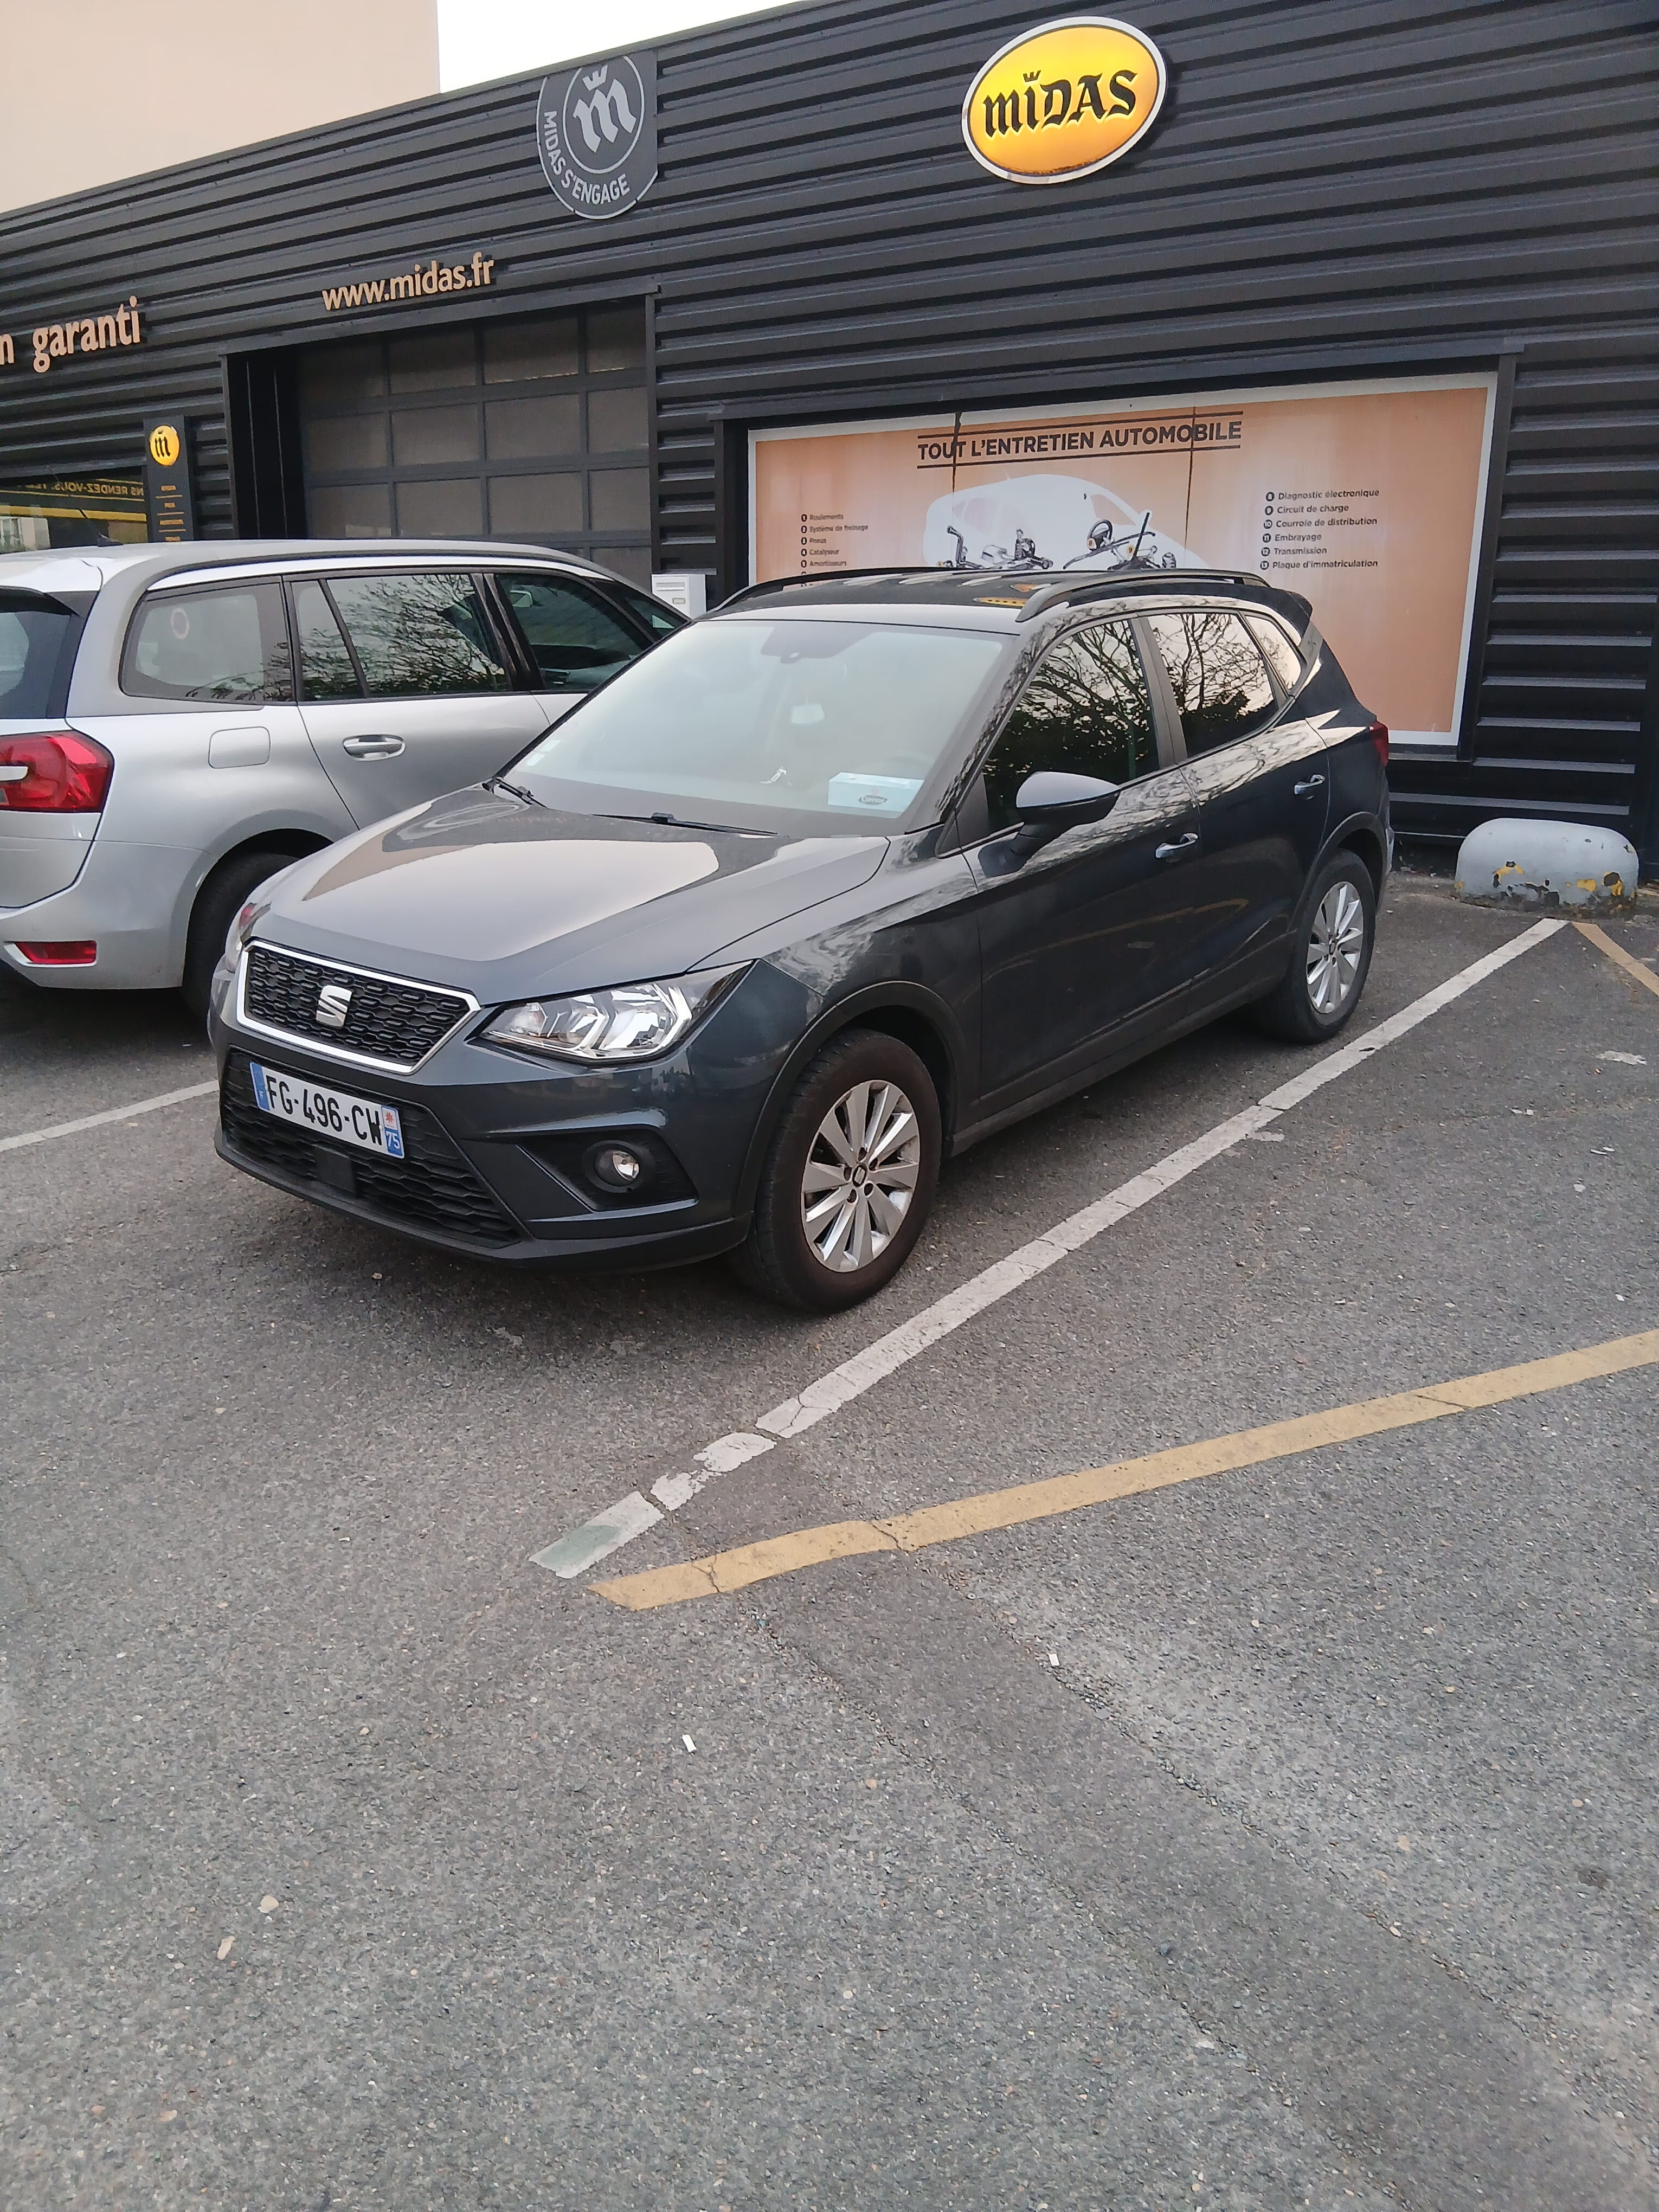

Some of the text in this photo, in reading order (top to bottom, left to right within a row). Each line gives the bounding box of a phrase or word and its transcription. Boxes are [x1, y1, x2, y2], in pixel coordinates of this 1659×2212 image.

[544, 111, 631, 204] MIDAS S'ENGAGE
[322, 252, 494, 311] www.midas.fr
[33, 295, 140, 373] garanti
[917, 421, 1242, 461] TOUT L'ENTRETIEN AUTOMOBILE
[1278, 491, 1322, 500] Diagnostic
[1325, 489, 1379, 498] électronique
[1320, 505, 1349, 513] charge
[1328, 517, 1377, 526] distribution
[1275, 533, 1322, 542] Embrayage
[1274, 546, 1327, 555] Transmission
[1272, 561, 1300, 569] Plaque
[1303, 560, 1378, 568] d'immatriculation
[266, 1075, 382, 1146] FG-496-CW
[385, 1130, 400, 1149] 75
